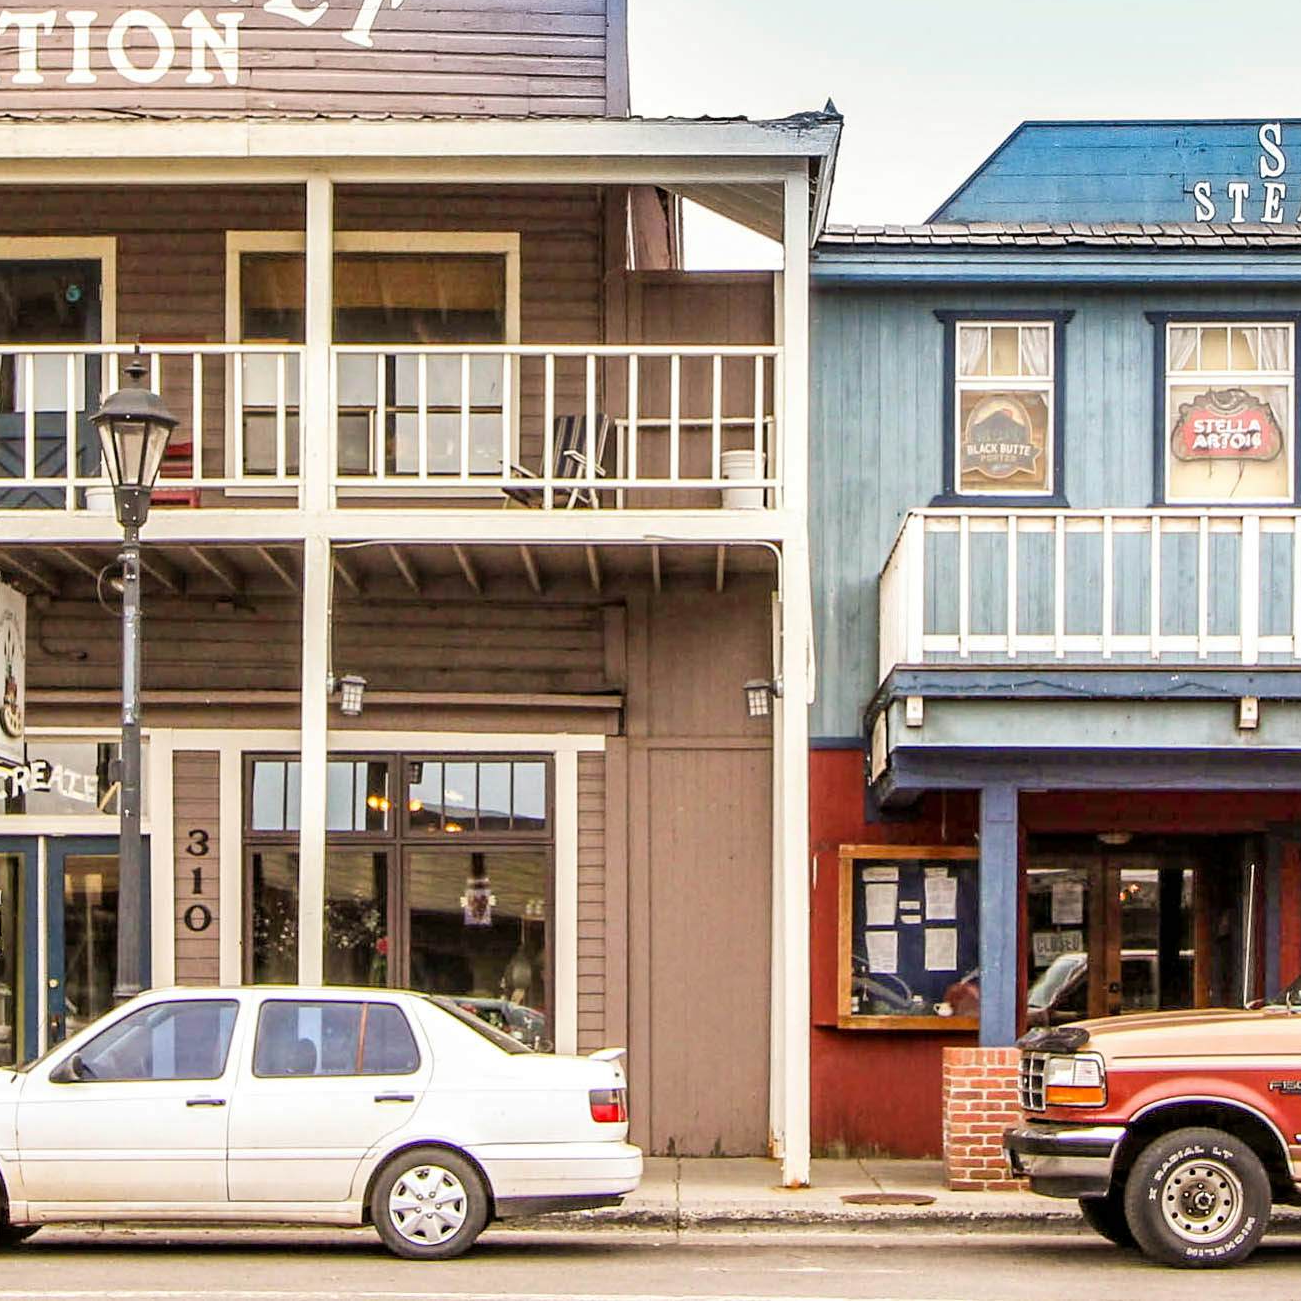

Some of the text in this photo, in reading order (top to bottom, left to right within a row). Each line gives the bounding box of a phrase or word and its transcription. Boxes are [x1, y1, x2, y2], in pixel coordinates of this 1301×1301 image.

[1193, 419, 1261, 433] STELLA
[966, 443, 1032, 456] BLACK BUTTE
[1192, 433, 1262, 449] ARTOIS
[184, 829, 212, 932] 310
[1154, 1146, 1204, 1181] RADIAL
[1213, 1147, 1234, 1159] LT
[1186, 1217, 1256, 1257] MICHELIN
